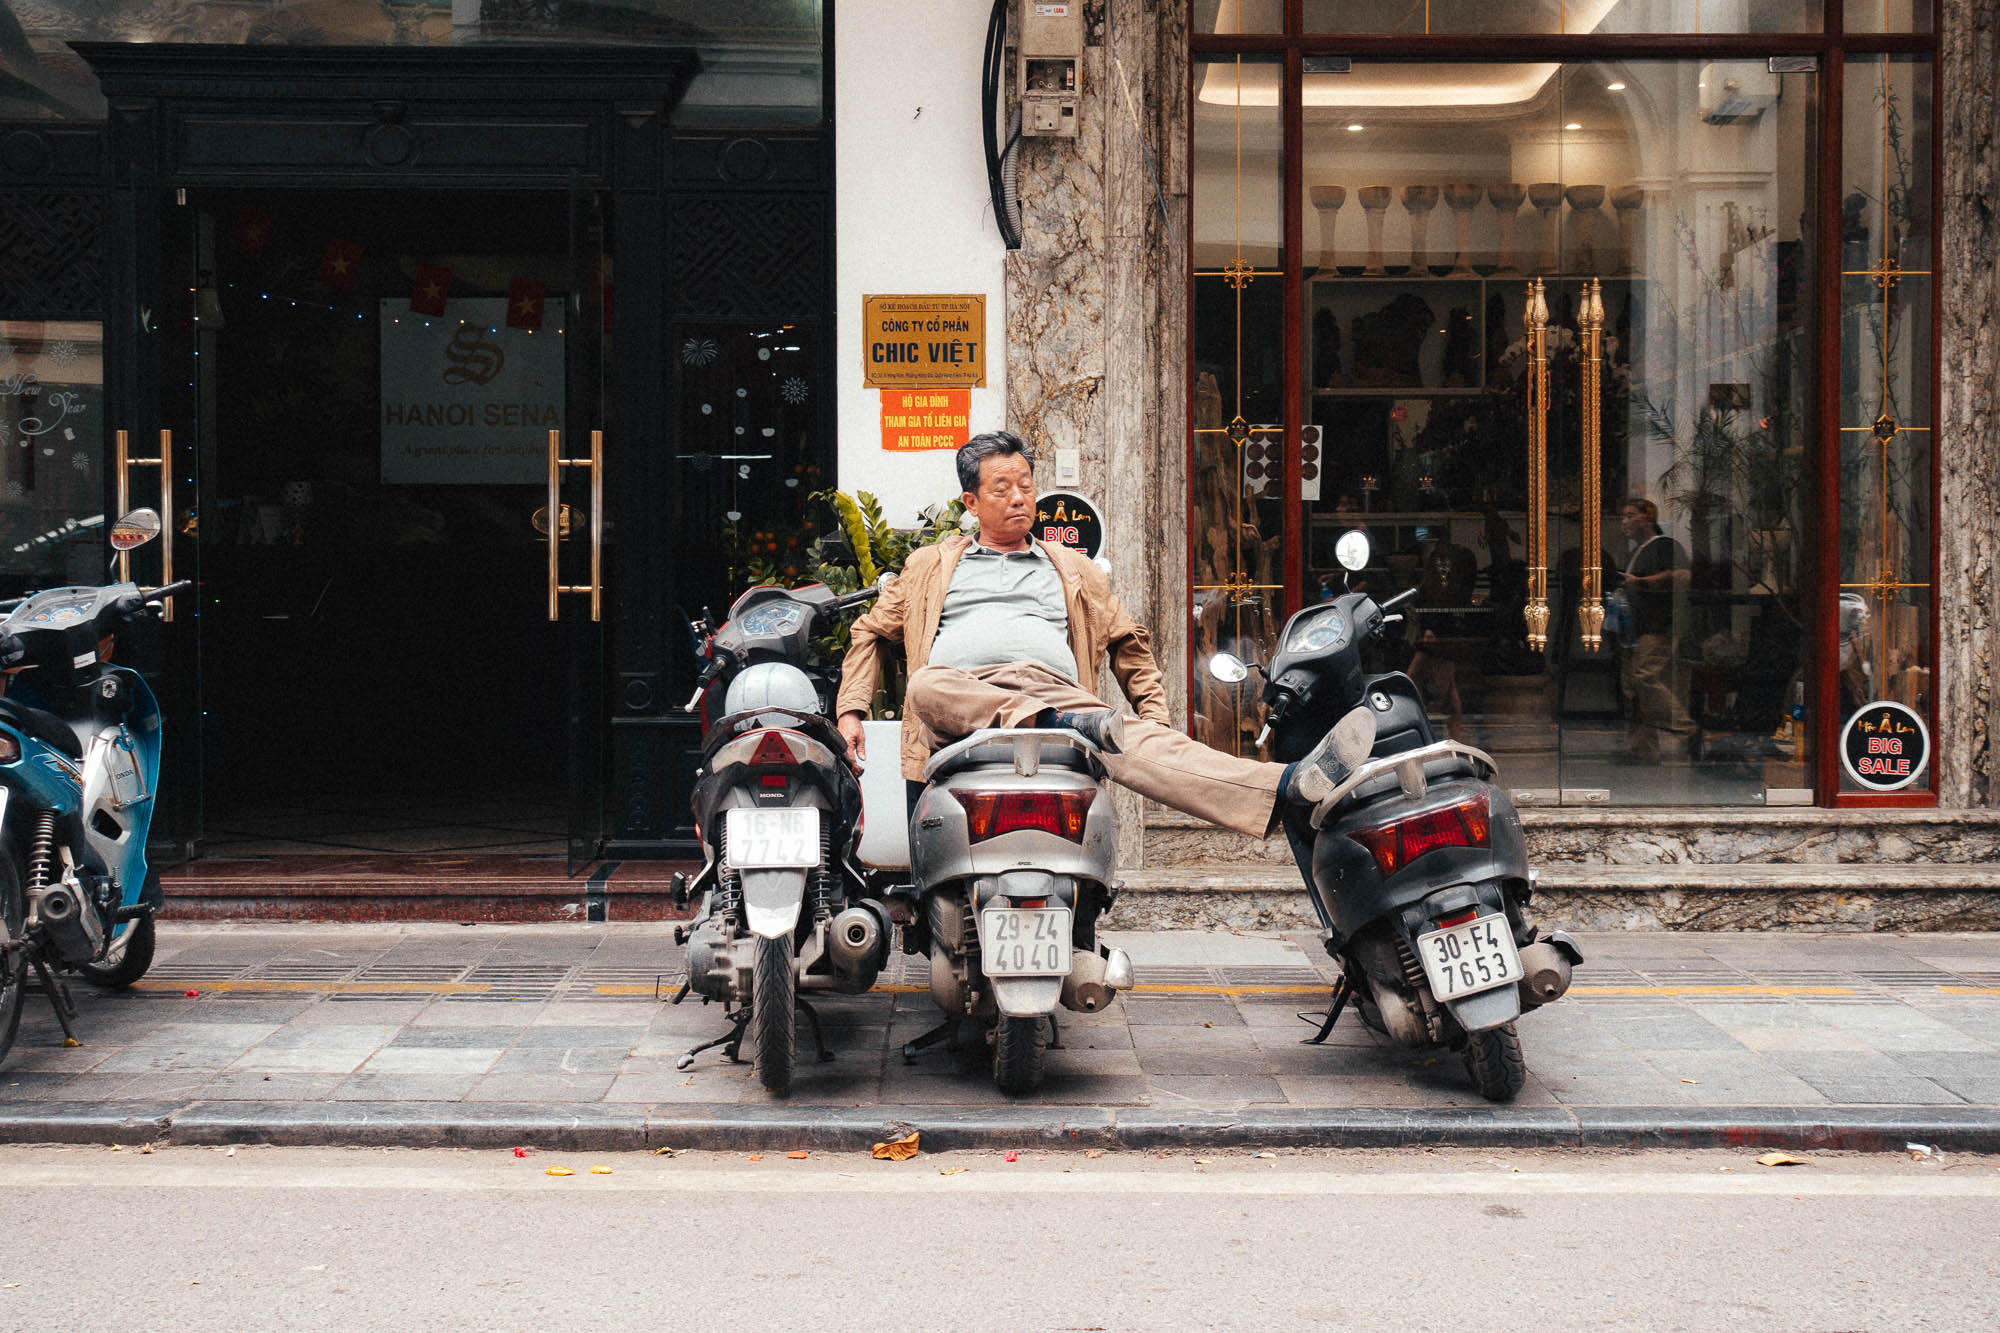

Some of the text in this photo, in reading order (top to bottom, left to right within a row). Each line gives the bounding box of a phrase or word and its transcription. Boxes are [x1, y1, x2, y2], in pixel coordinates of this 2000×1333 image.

[882, 315, 969, 332] CÔNG TY CỔ PHẦN
[872, 338, 978, 367] CHIC VIỆT
[902, 393, 949, 411] HỘ GIA ĐÌNH
[385, 403, 561, 426] HANOI SENA
[884, 415, 906, 428] THAM
[908, 415, 921, 428] GIA
[934, 412, 952, 428] LIÊN
[953, 415, 967, 428] GIA
[898, 432, 954, 448] AN TOÀN PCCC
[1044, 527, 1079, 544] BIG
[1868, 737, 1903, 755] BIG
[115, 769, 134, 780] ONDA
[1858, 757, 1911, 776] SALE
[742, 839, 805, 865] 7742
[996, 913, 1058, 941] 29-Z4
[1433, 921, 1498, 963] 30-F4
[996, 944, 1058, 971] 4040
[1442, 952, 1508, 993] 7653
